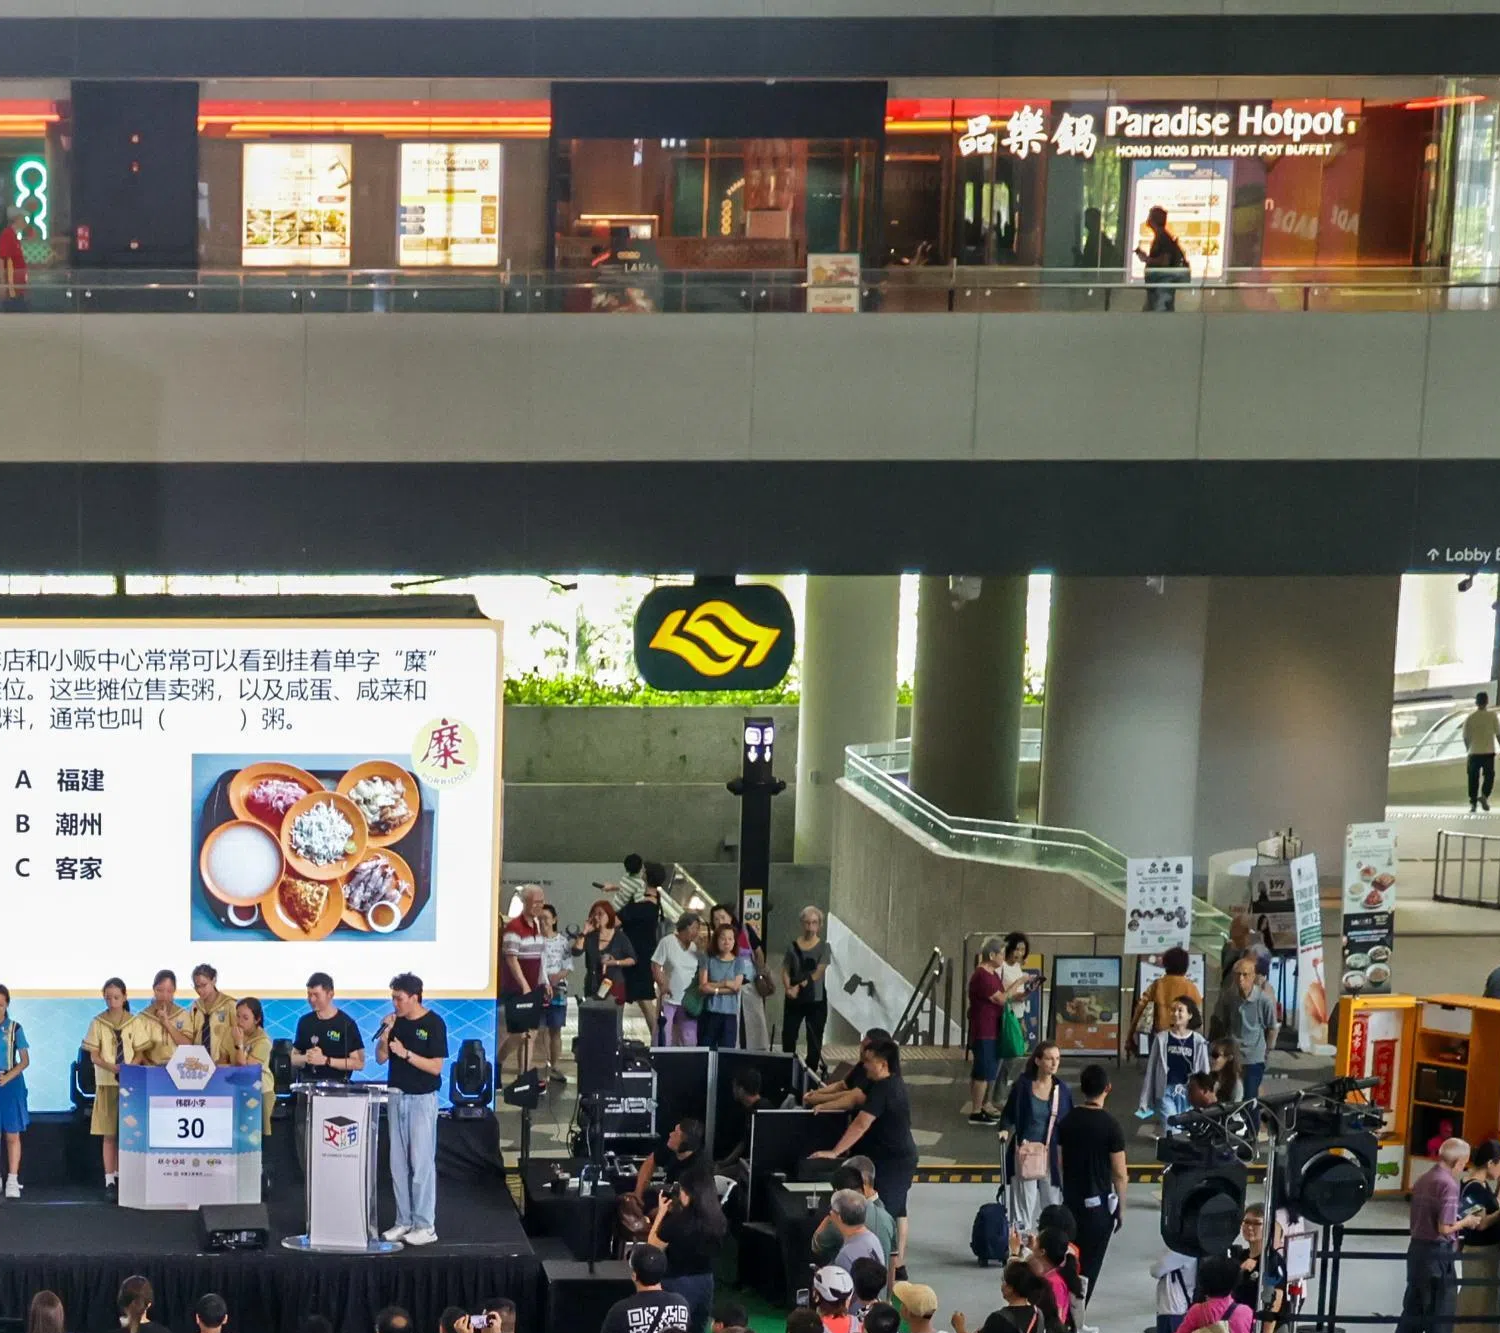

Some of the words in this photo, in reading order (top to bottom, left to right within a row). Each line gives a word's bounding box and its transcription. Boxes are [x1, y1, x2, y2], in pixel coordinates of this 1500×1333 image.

[1103, 104, 1230, 139] Paradise
[1238, 105, 1347, 143] Hotpot
[1115, 143, 1151, 158] HONG
[1153, 143, 1188, 157] KONG
[1190, 143, 1229, 158] STYLE
[1231, 142, 1256, 157] HOT
[1259, 142, 1284, 157] POT
[1285, 142, 1332, 157] BUFFET
[1446, 547, 1491, 565] Lobby
[177, 1117, 206, 1140] 30
